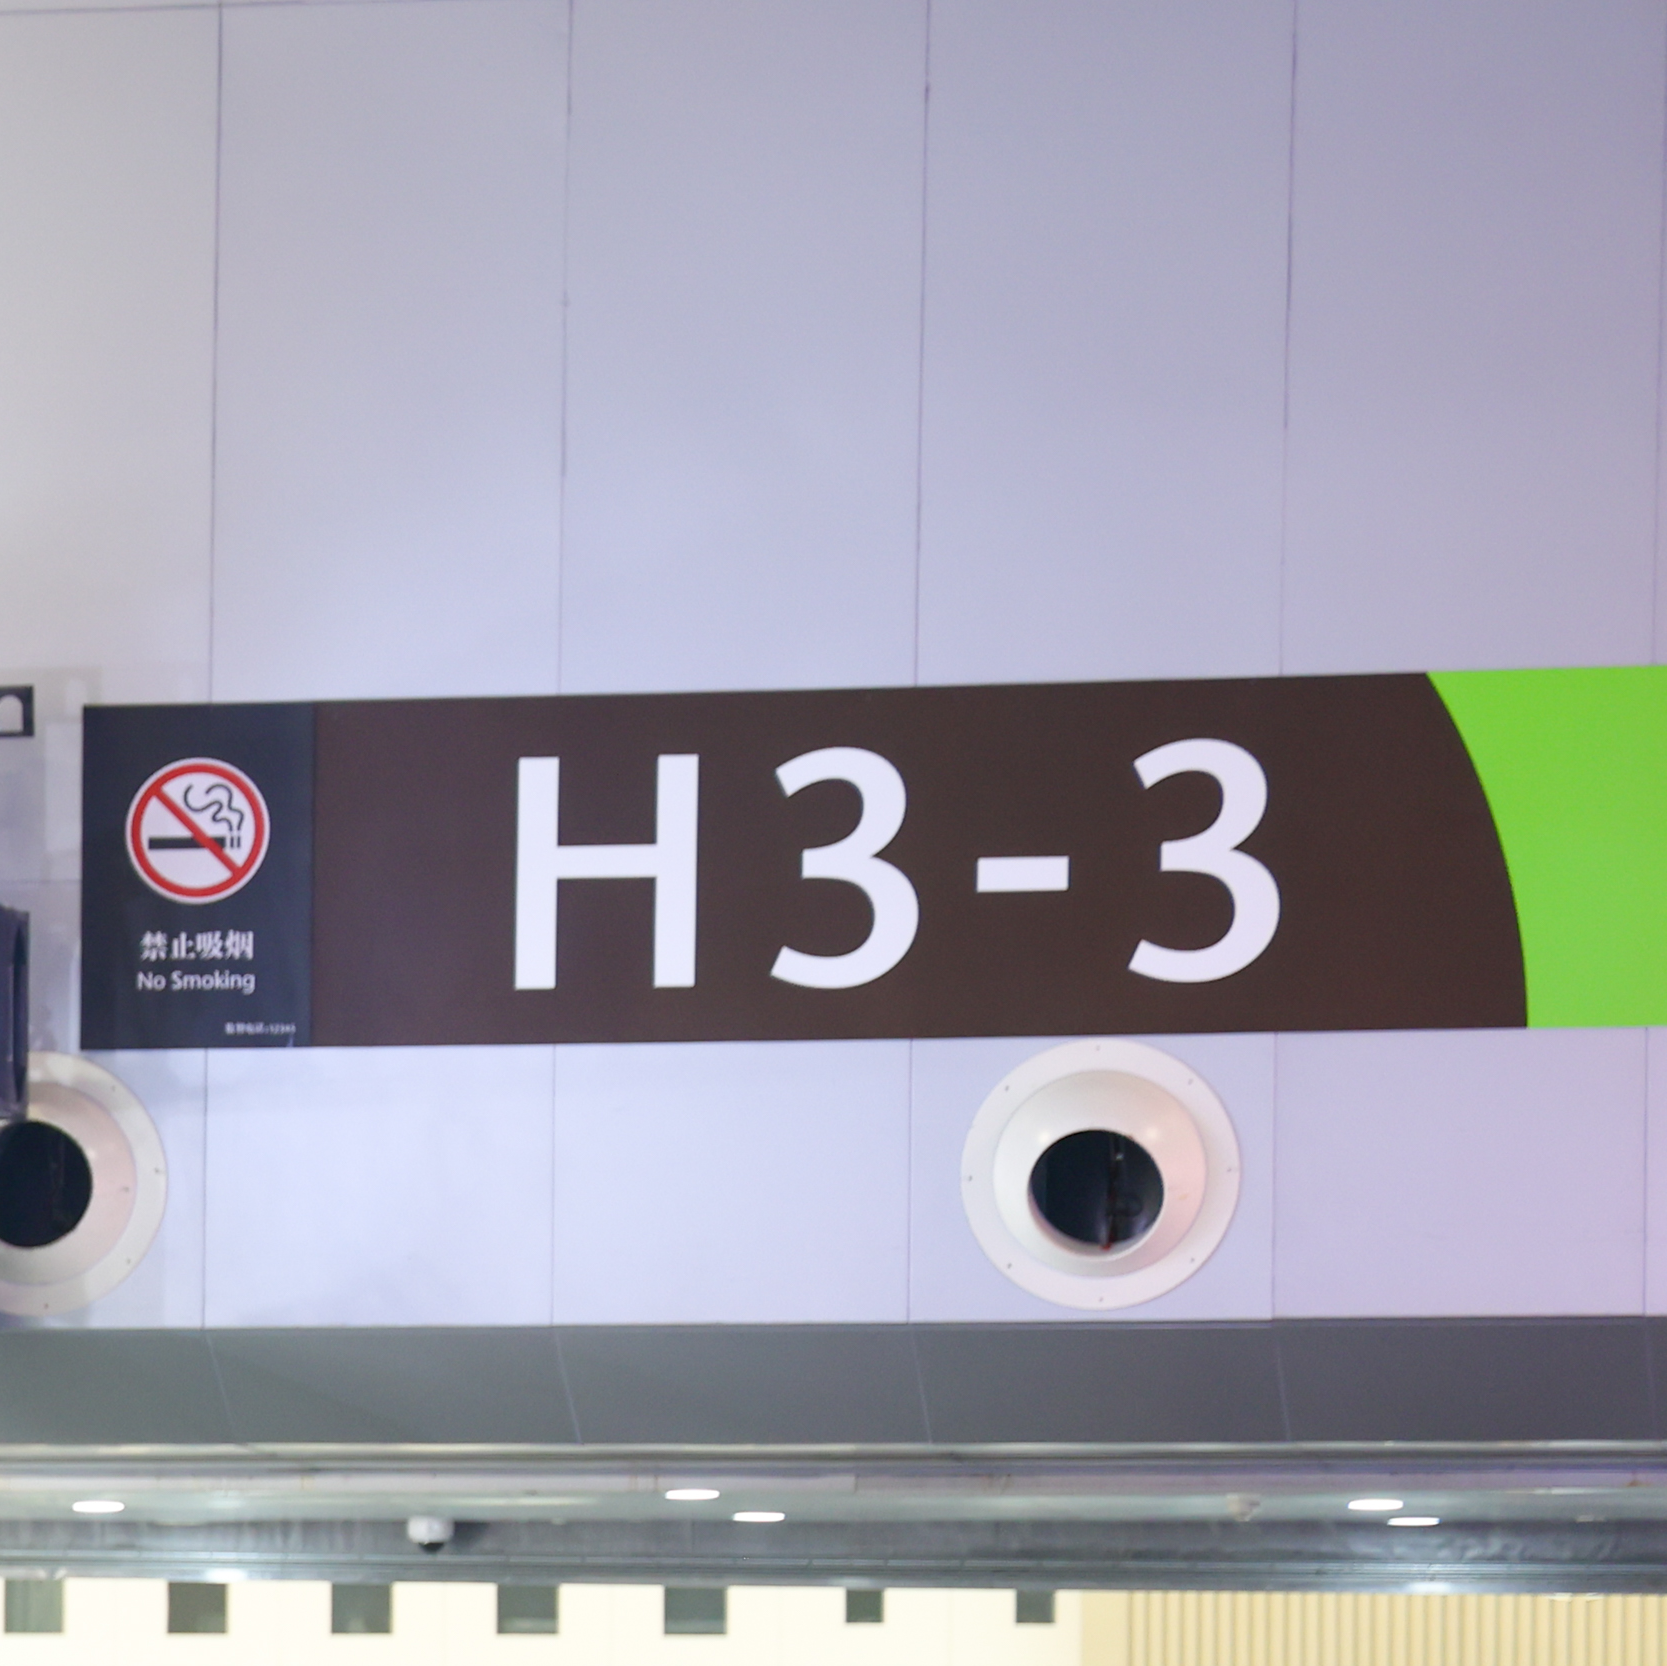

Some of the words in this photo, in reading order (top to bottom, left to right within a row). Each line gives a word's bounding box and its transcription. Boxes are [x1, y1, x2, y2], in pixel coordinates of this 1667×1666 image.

[140, 930, 255, 962] 禁止吸烟
[136, 971, 166, 991] No
[171, 970, 256, 995] Smoking
